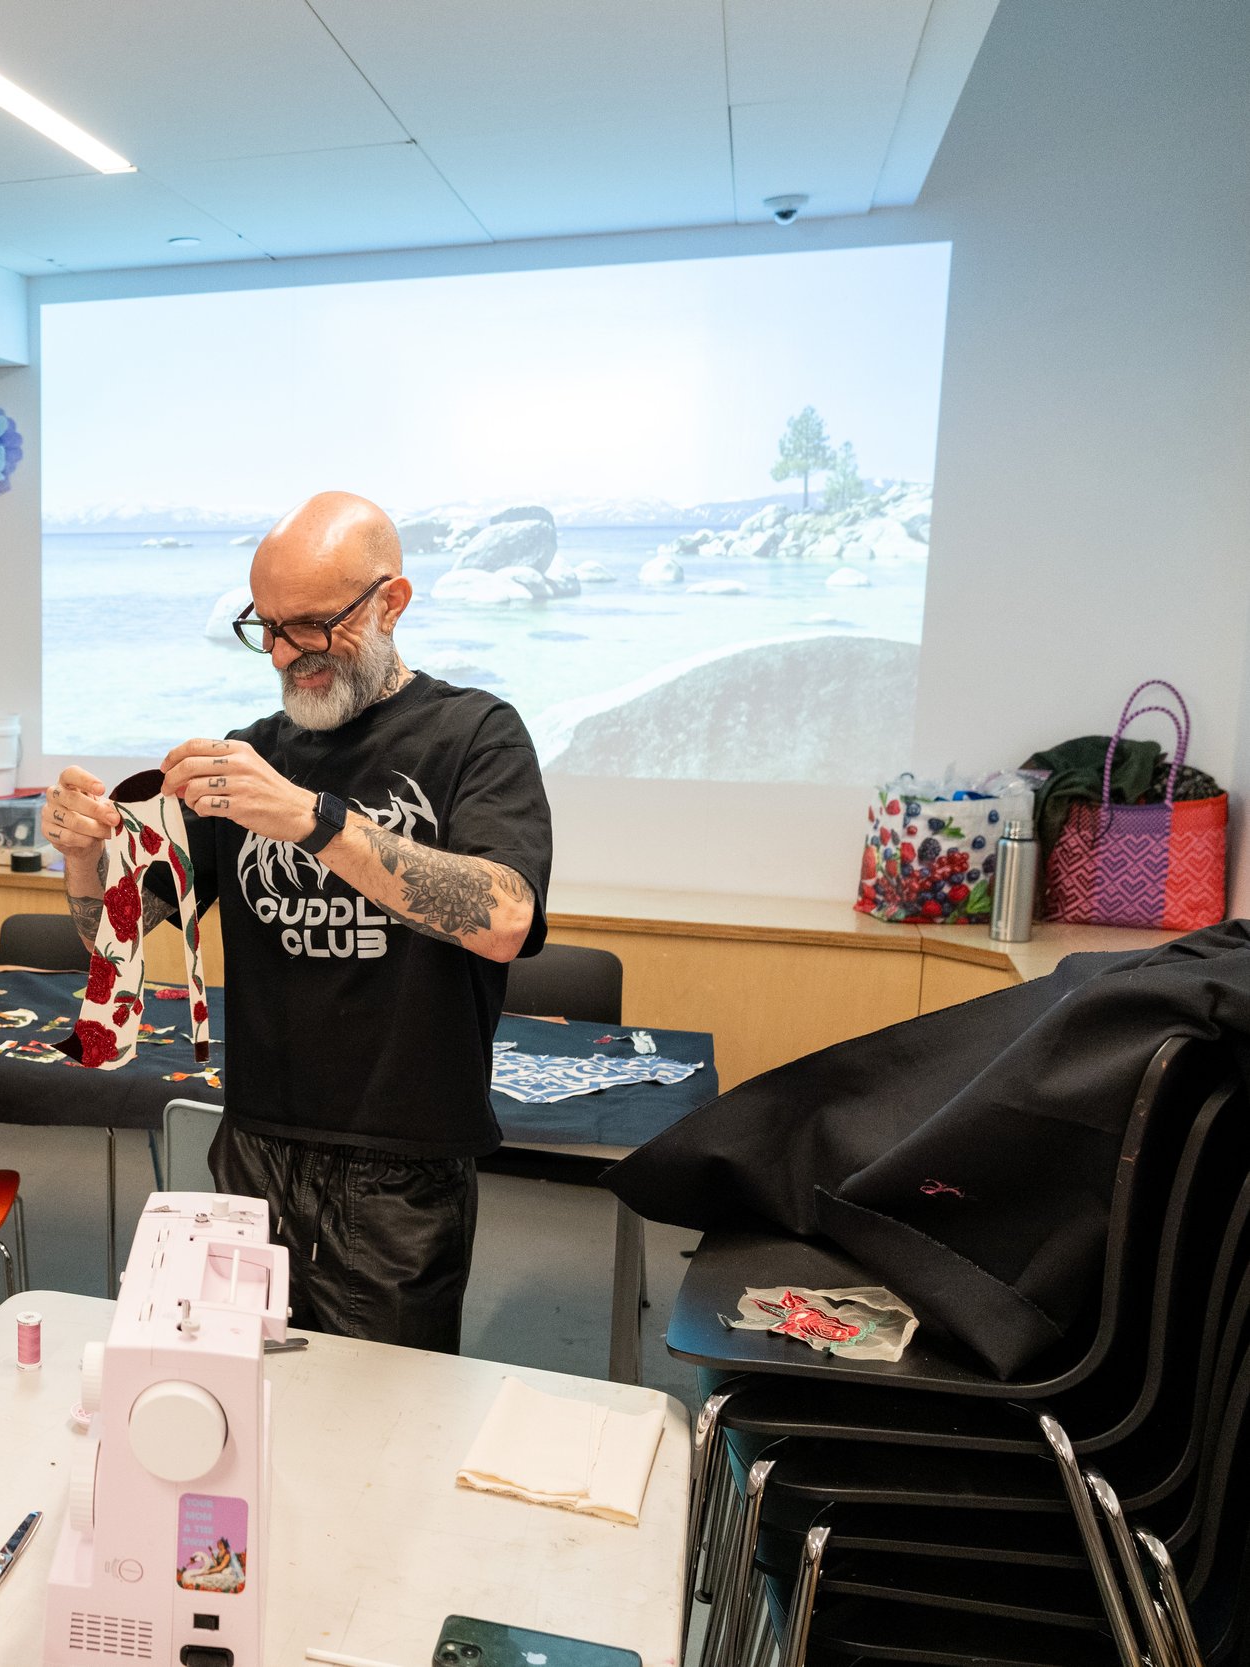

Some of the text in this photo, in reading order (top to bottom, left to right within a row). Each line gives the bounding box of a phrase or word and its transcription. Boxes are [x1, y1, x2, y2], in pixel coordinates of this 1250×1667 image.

[255, 896, 401, 926] CUDDL
[281, 929, 388, 959] CLUB
[185, 1497, 214, 1509] YOUR
[185, 1510, 213, 1521] MOM
[195, 1524, 214, 1535] THE
[182, 1536, 214, 1548] SWAN
